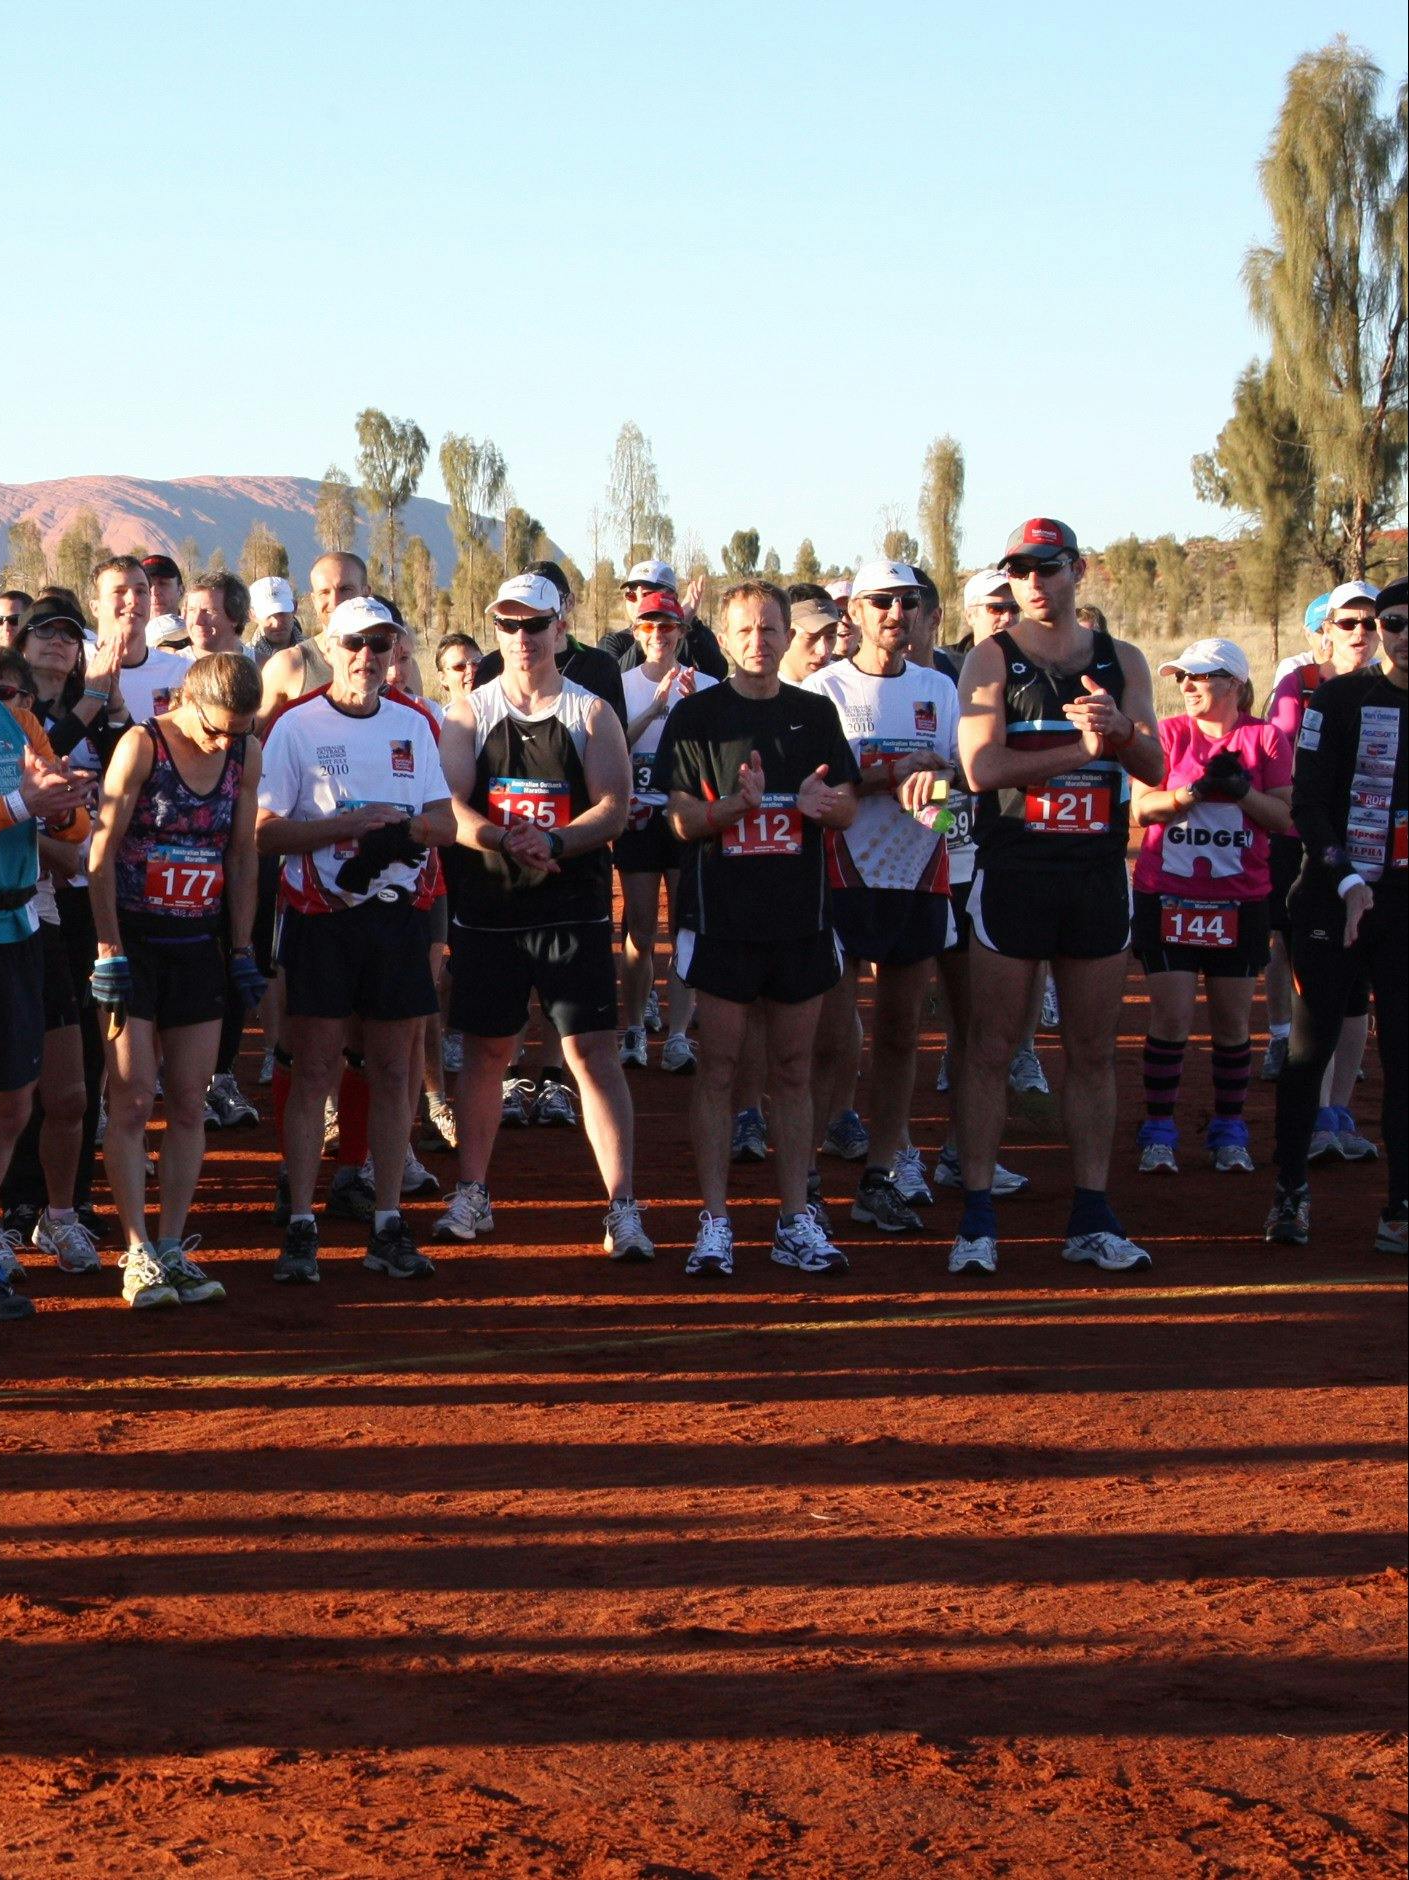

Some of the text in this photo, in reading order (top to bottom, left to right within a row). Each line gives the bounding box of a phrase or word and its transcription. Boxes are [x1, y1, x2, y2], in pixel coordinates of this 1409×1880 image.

[848, 722, 875, 733] 2010
[882, 740, 908, 748] Australian
[320, 764, 349, 777] 2010
[638, 766, 652, 787] 3
[511, 780, 539, 788] Australian
[497, 798, 556, 828] 135
[1036, 792, 1093, 821] 121
[735, 813, 791, 844] 112
[172, 848, 200, 856] Australian
[184, 855, 208, 863] Marathon
[161, 867, 216, 898] 177
[1170, 912, 1225, 938] 144
